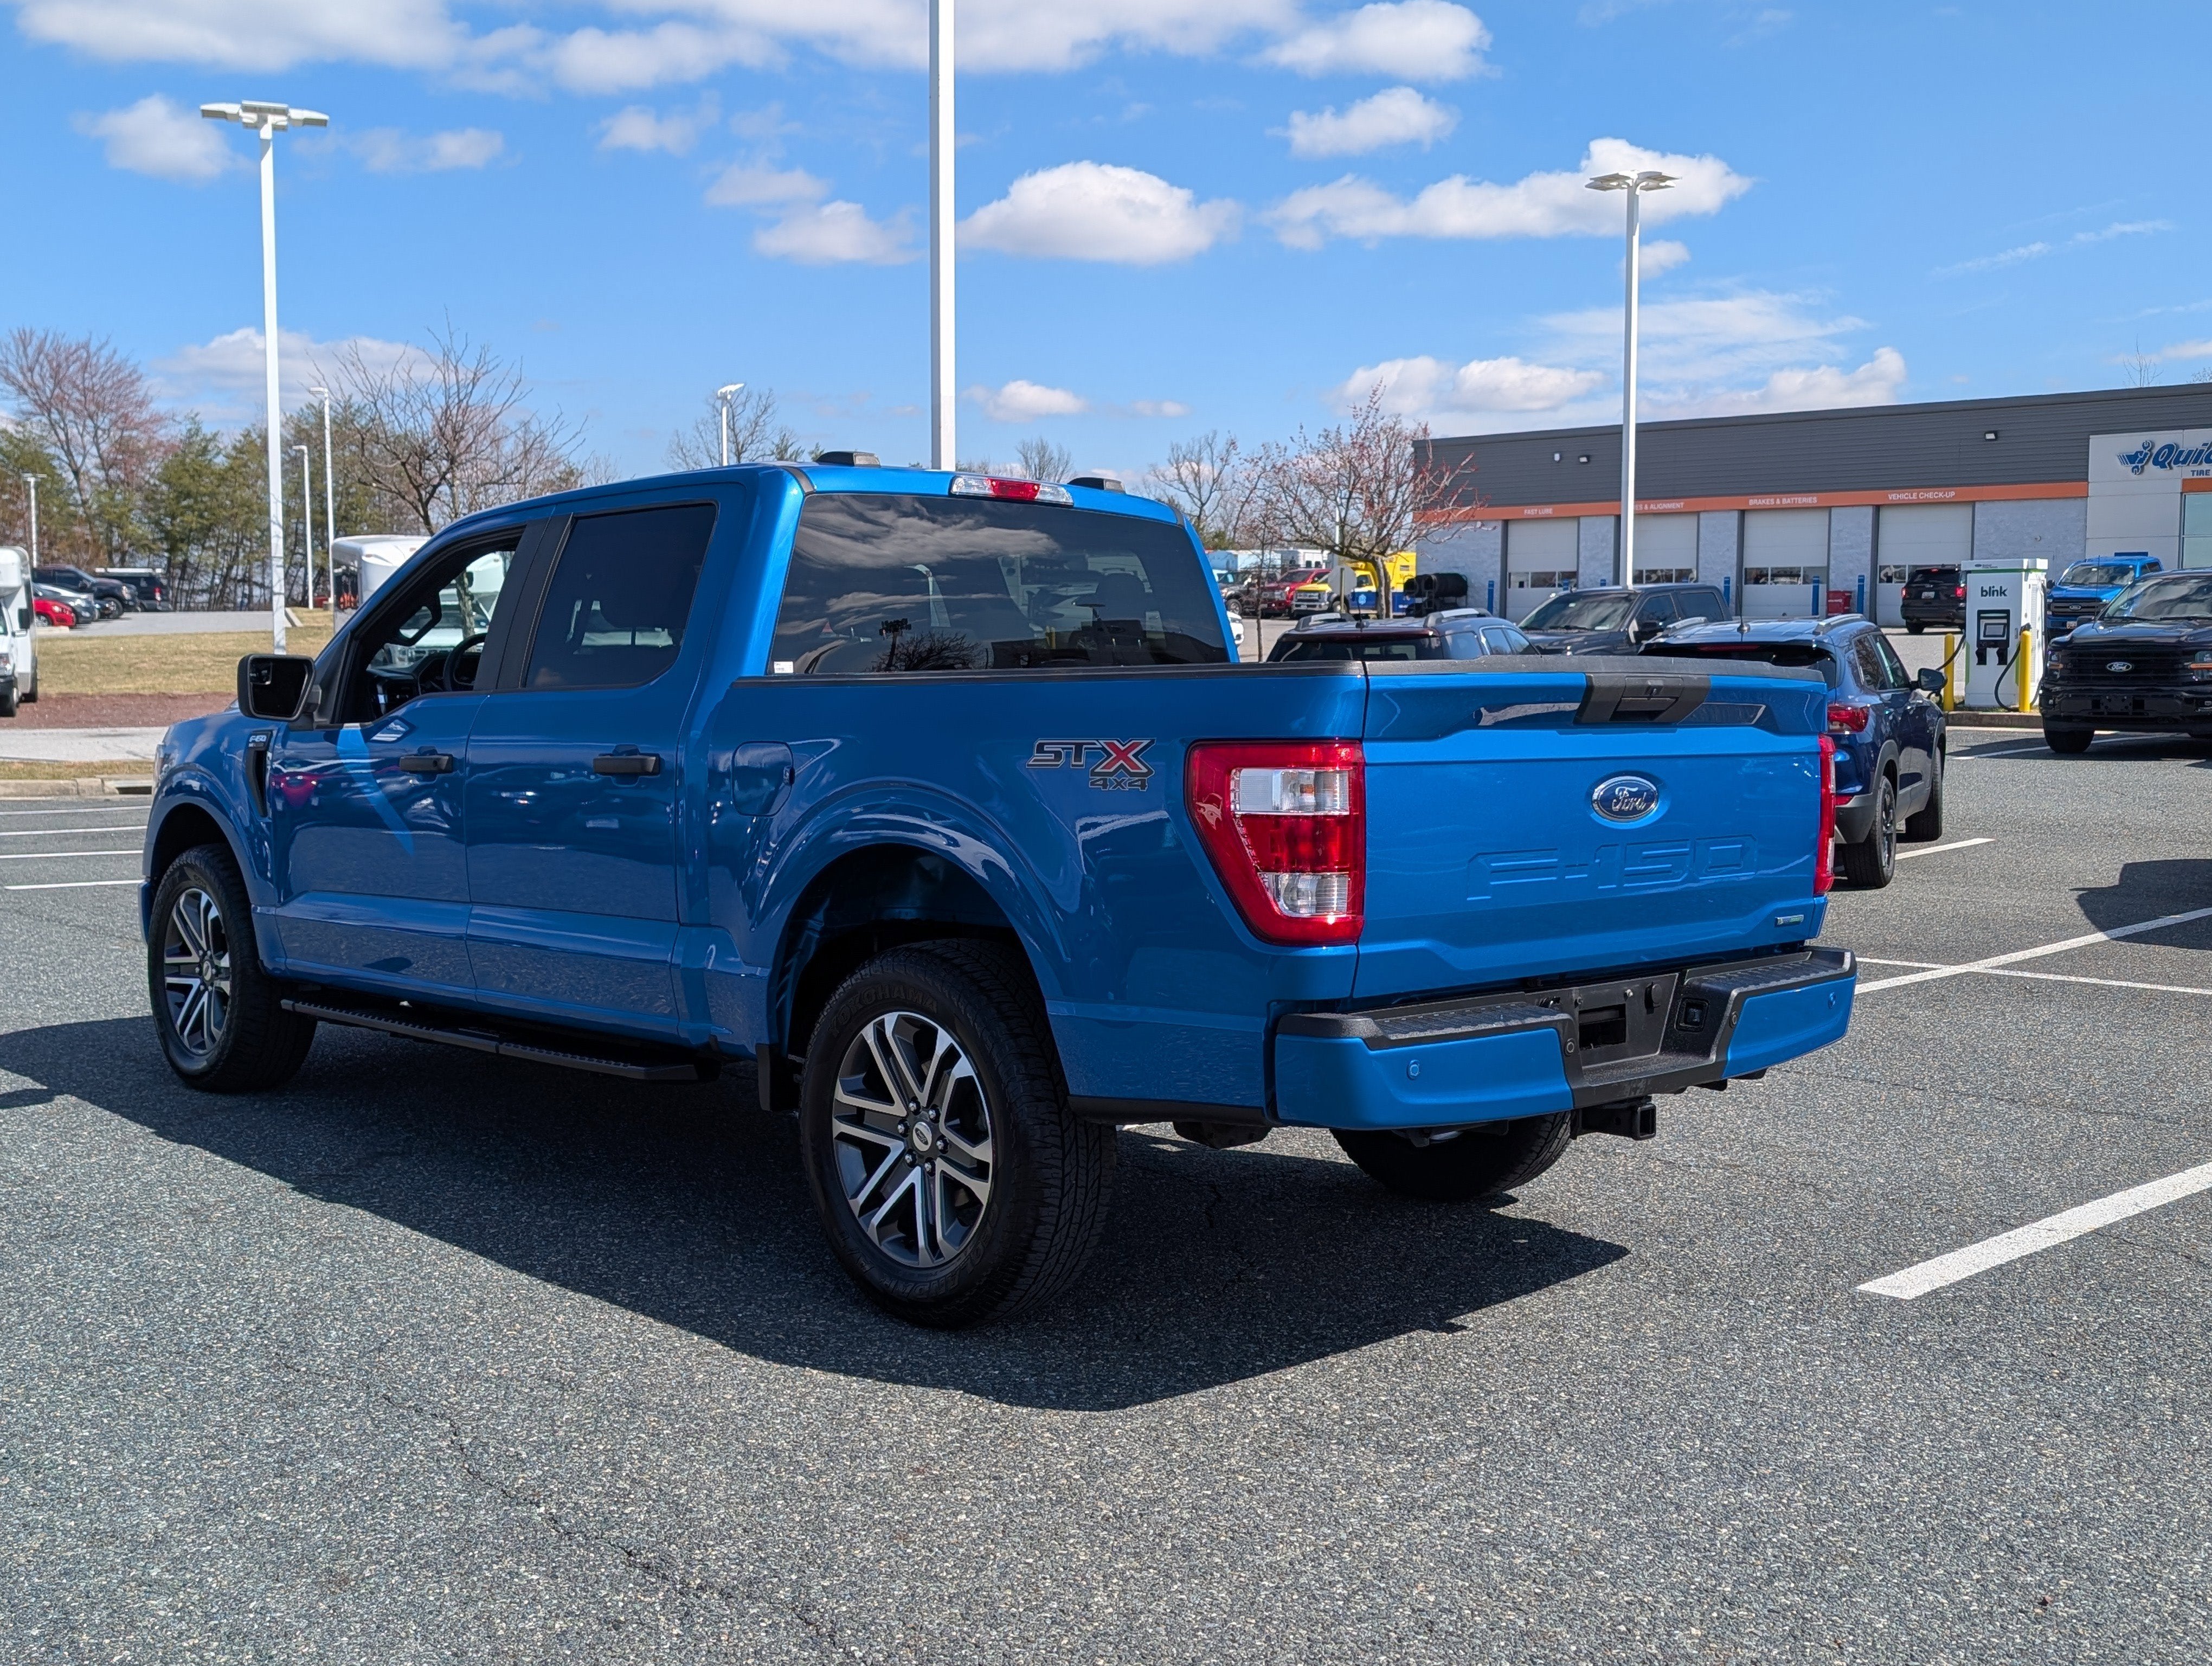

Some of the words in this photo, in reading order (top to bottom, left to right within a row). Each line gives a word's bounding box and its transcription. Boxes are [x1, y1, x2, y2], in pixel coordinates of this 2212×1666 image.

[1980, 586, 2008, 597] blink
[1026, 738, 1156, 778] STX
[1612, 786, 1647, 811] Ford
[1467, 834, 1757, 900] F-150
[827, 984, 938, 1038] YOKOHAMA
